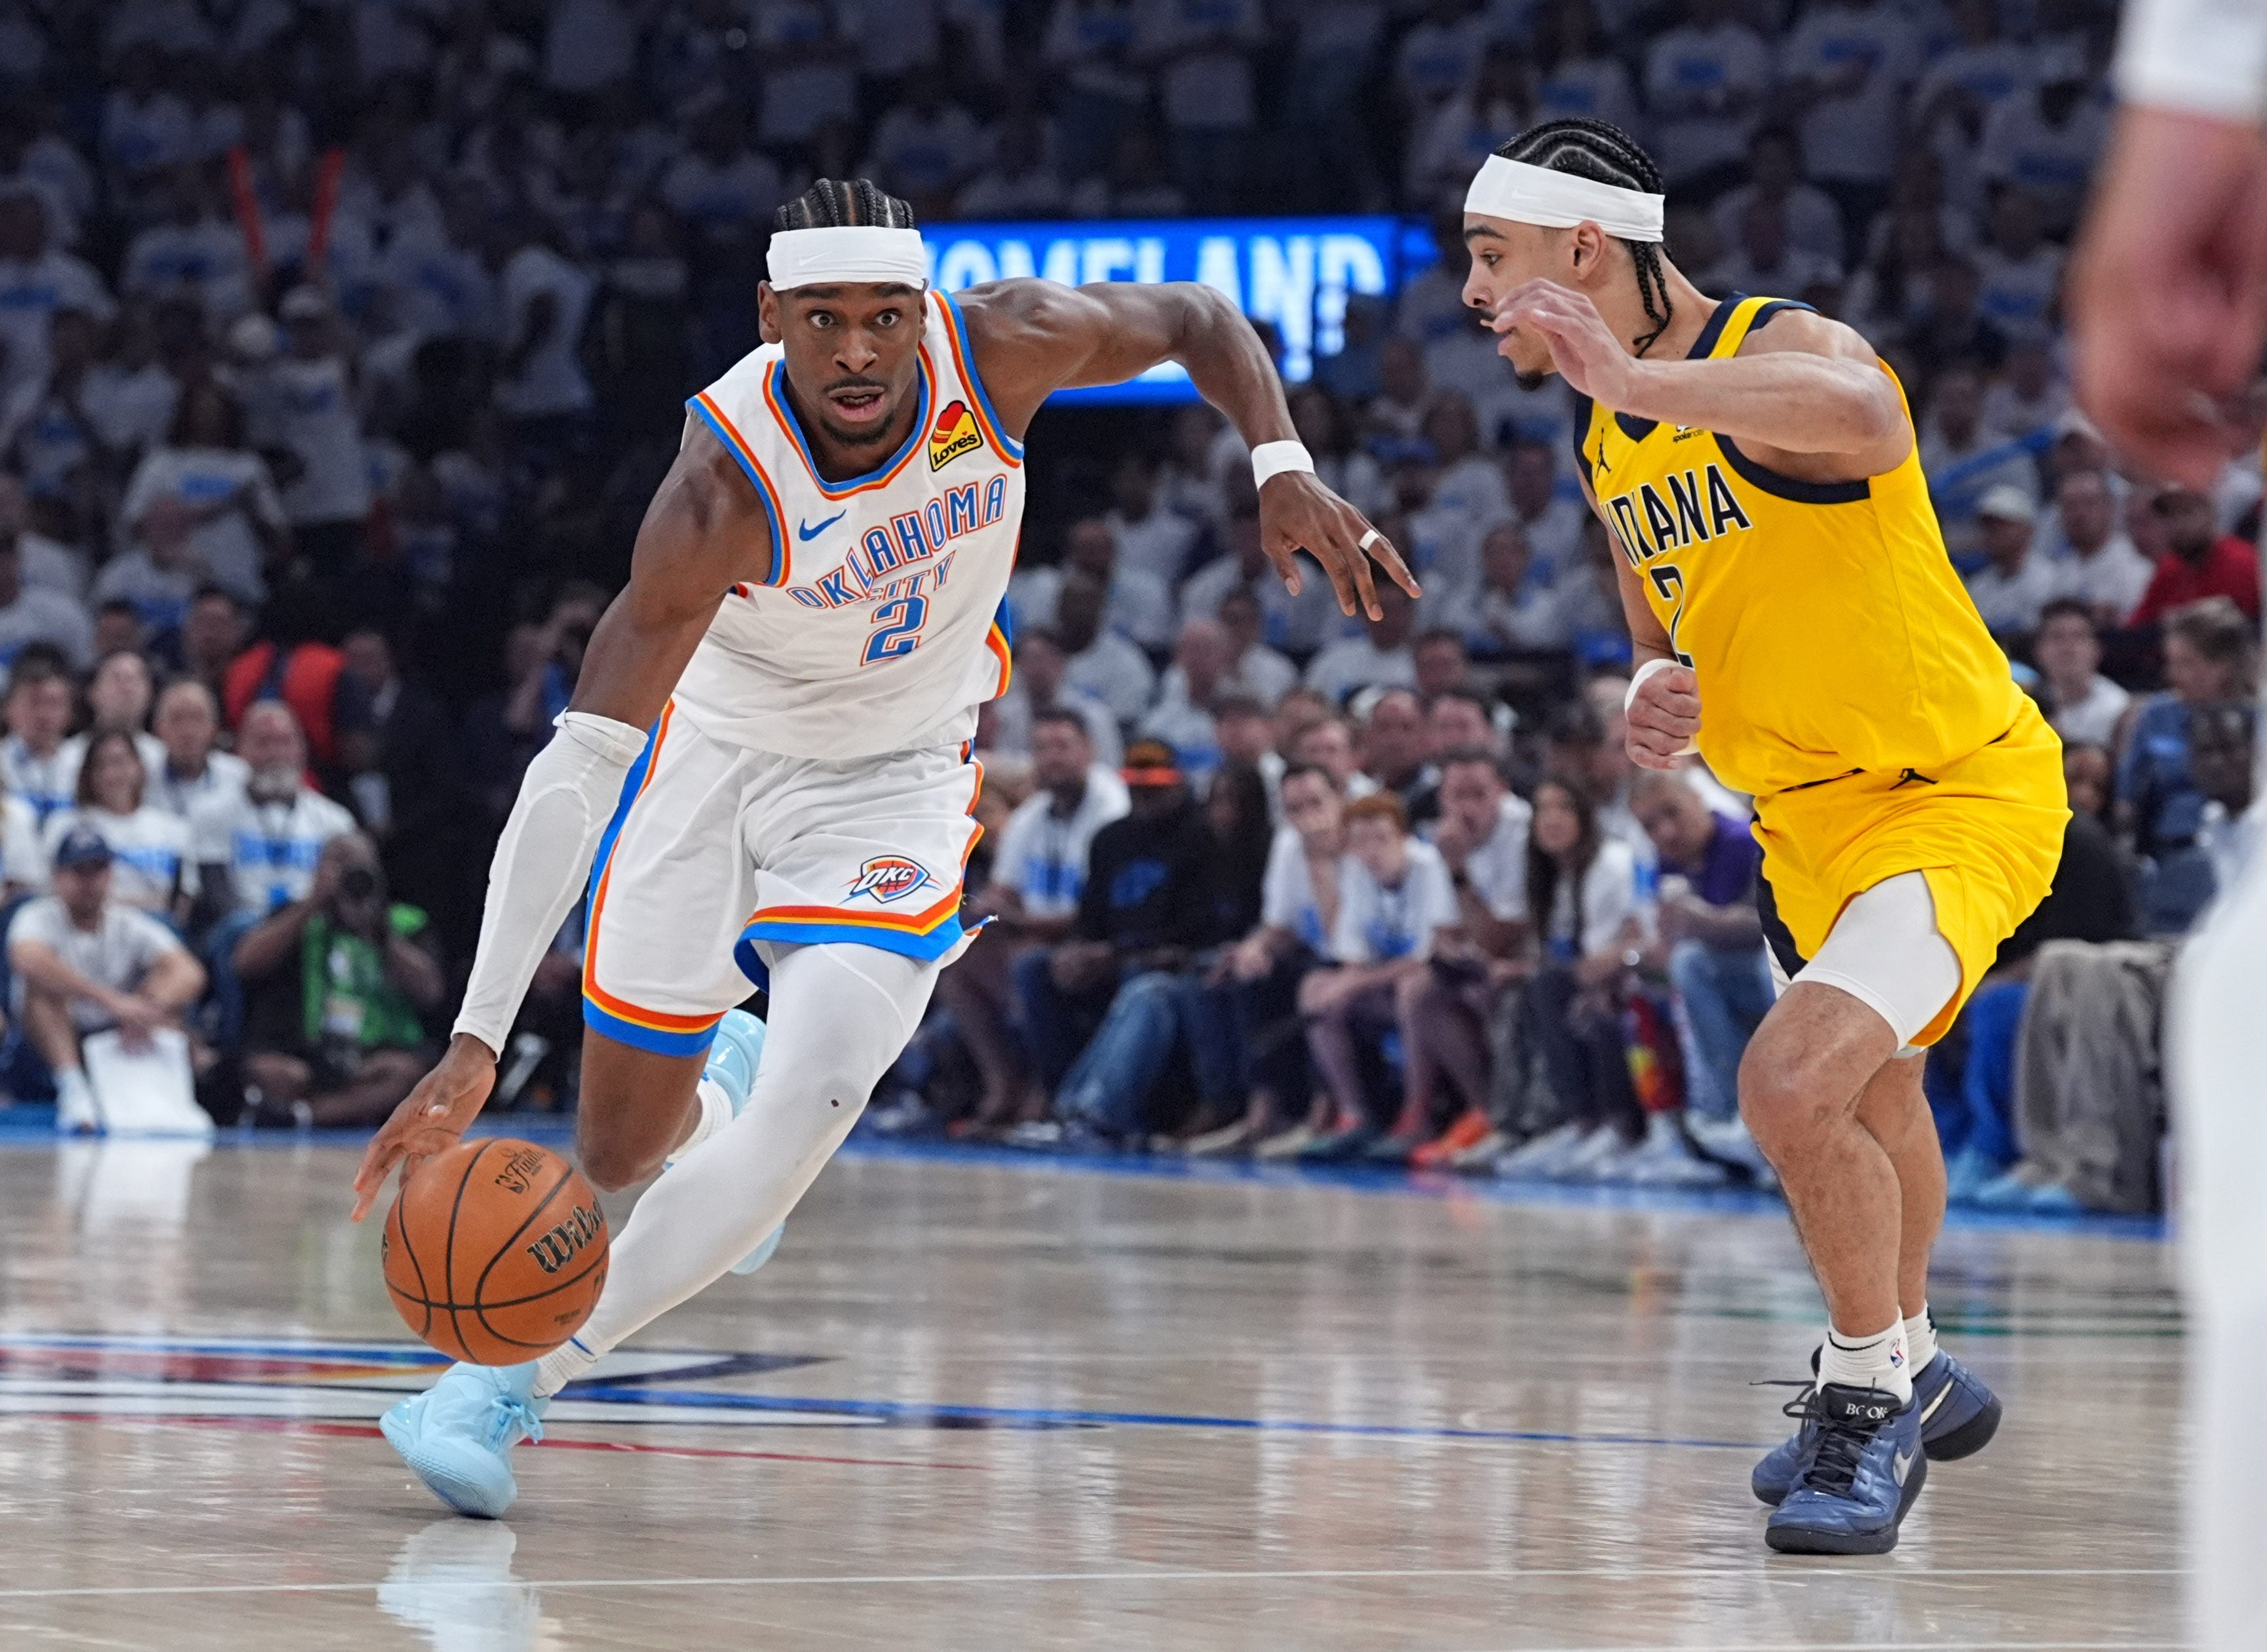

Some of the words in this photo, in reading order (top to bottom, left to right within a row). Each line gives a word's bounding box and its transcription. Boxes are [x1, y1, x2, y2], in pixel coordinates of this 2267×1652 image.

[787, 474, 1007, 609] OKLAHOMA
[860, 593, 929, 667] 2
[849, 866, 915, 895] OKC
